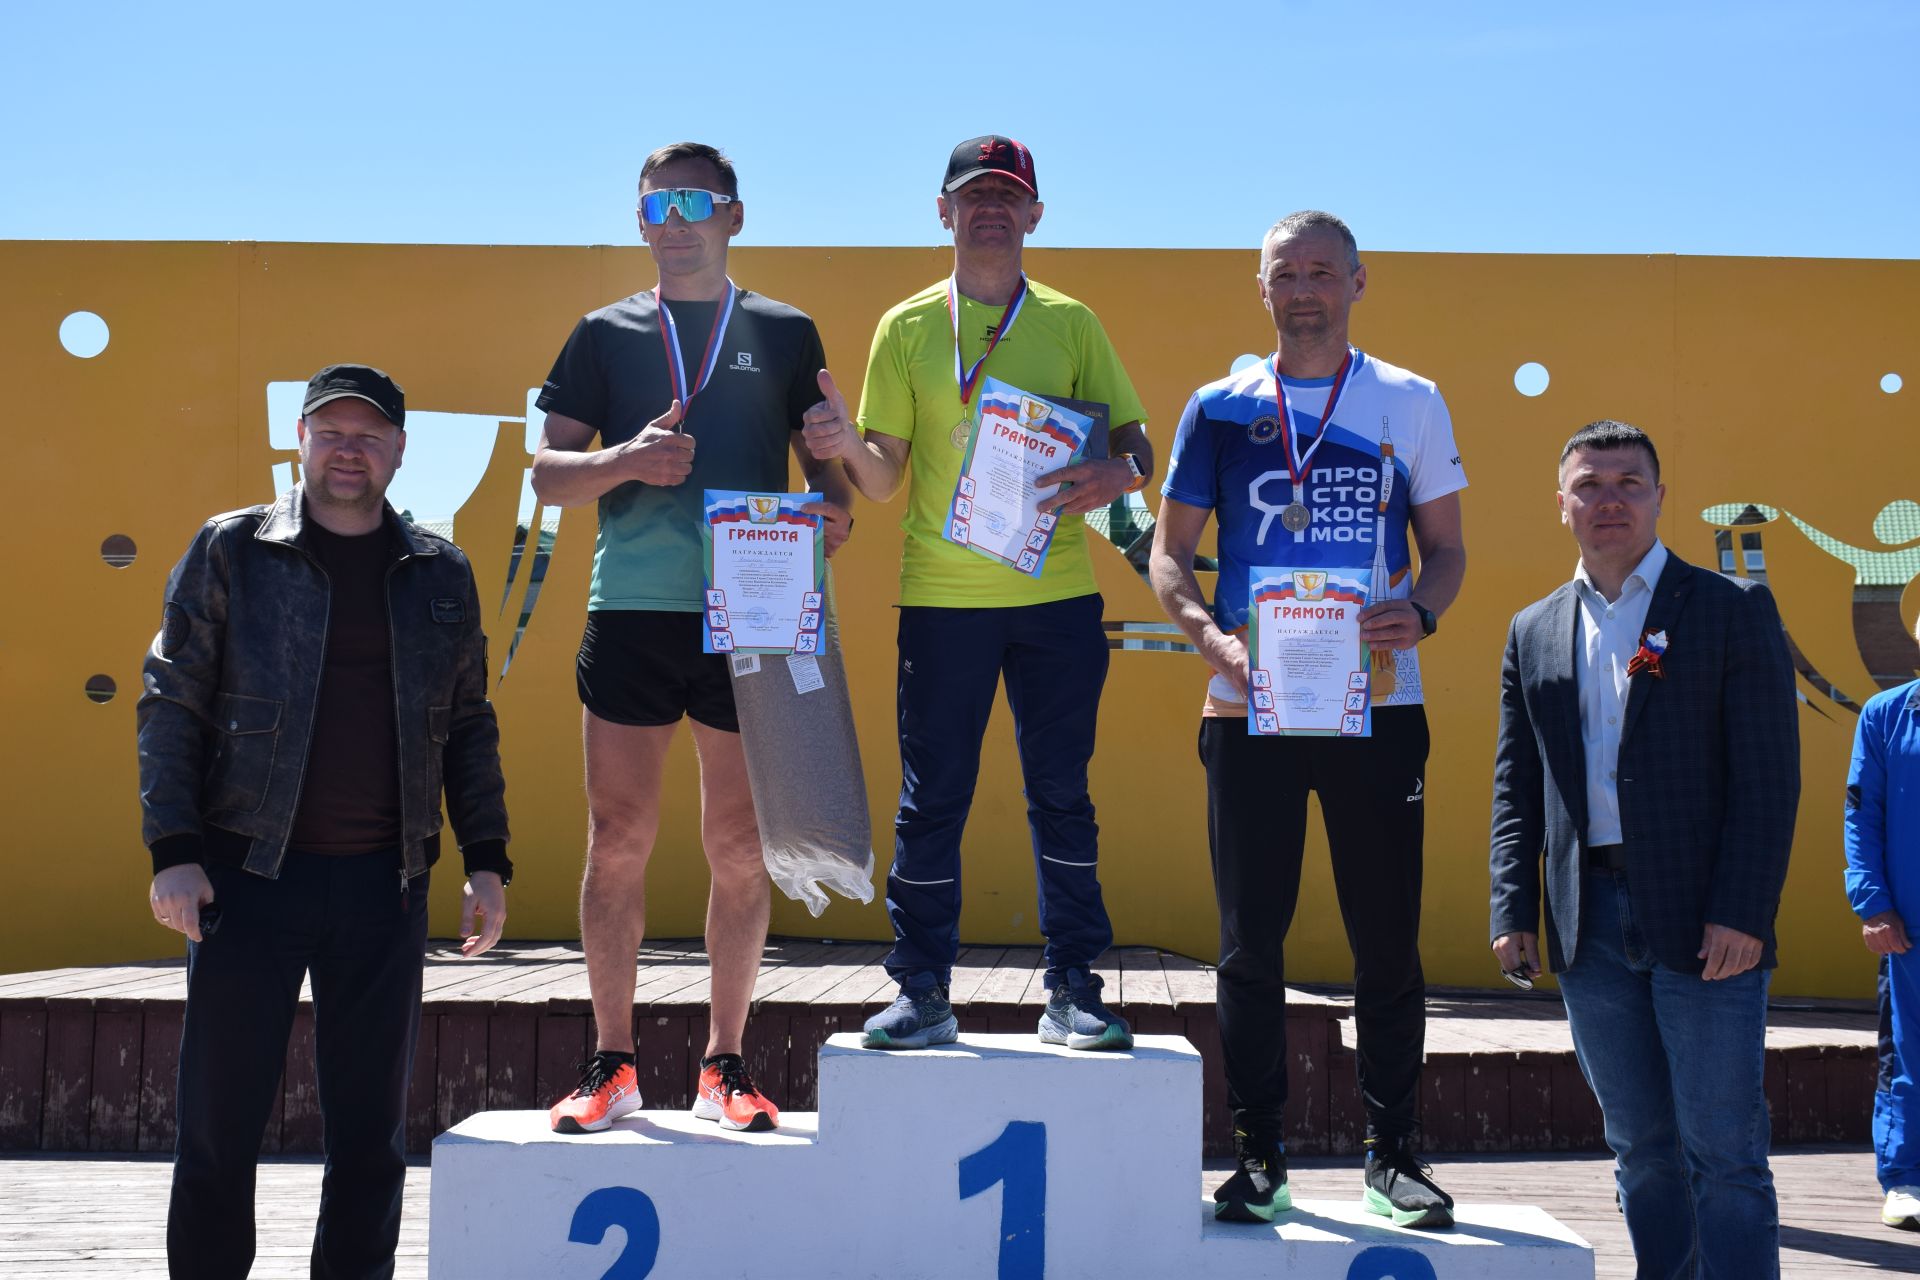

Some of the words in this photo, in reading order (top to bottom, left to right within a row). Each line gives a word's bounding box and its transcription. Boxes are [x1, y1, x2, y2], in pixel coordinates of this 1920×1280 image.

[992, 422, 1057, 458] ГРАМОТА
[1311, 467, 1378, 484] ПРО
[1311, 487, 1376, 503] СТО
[1312, 507, 1374, 523] КОС
[728, 528, 799, 542] ГРАМОТА
[1311, 526, 1373, 543] МОС
[732, 549, 793, 557] НАГРАЖДАЕТСЯ
[1274, 606, 1345, 620] ГРАМОТА
[1277, 628, 1339, 636] НАГРАЖДАЕТСЯ
[959, 1120, 1047, 1280] 1
[568, 1186, 660, 1280] 2
